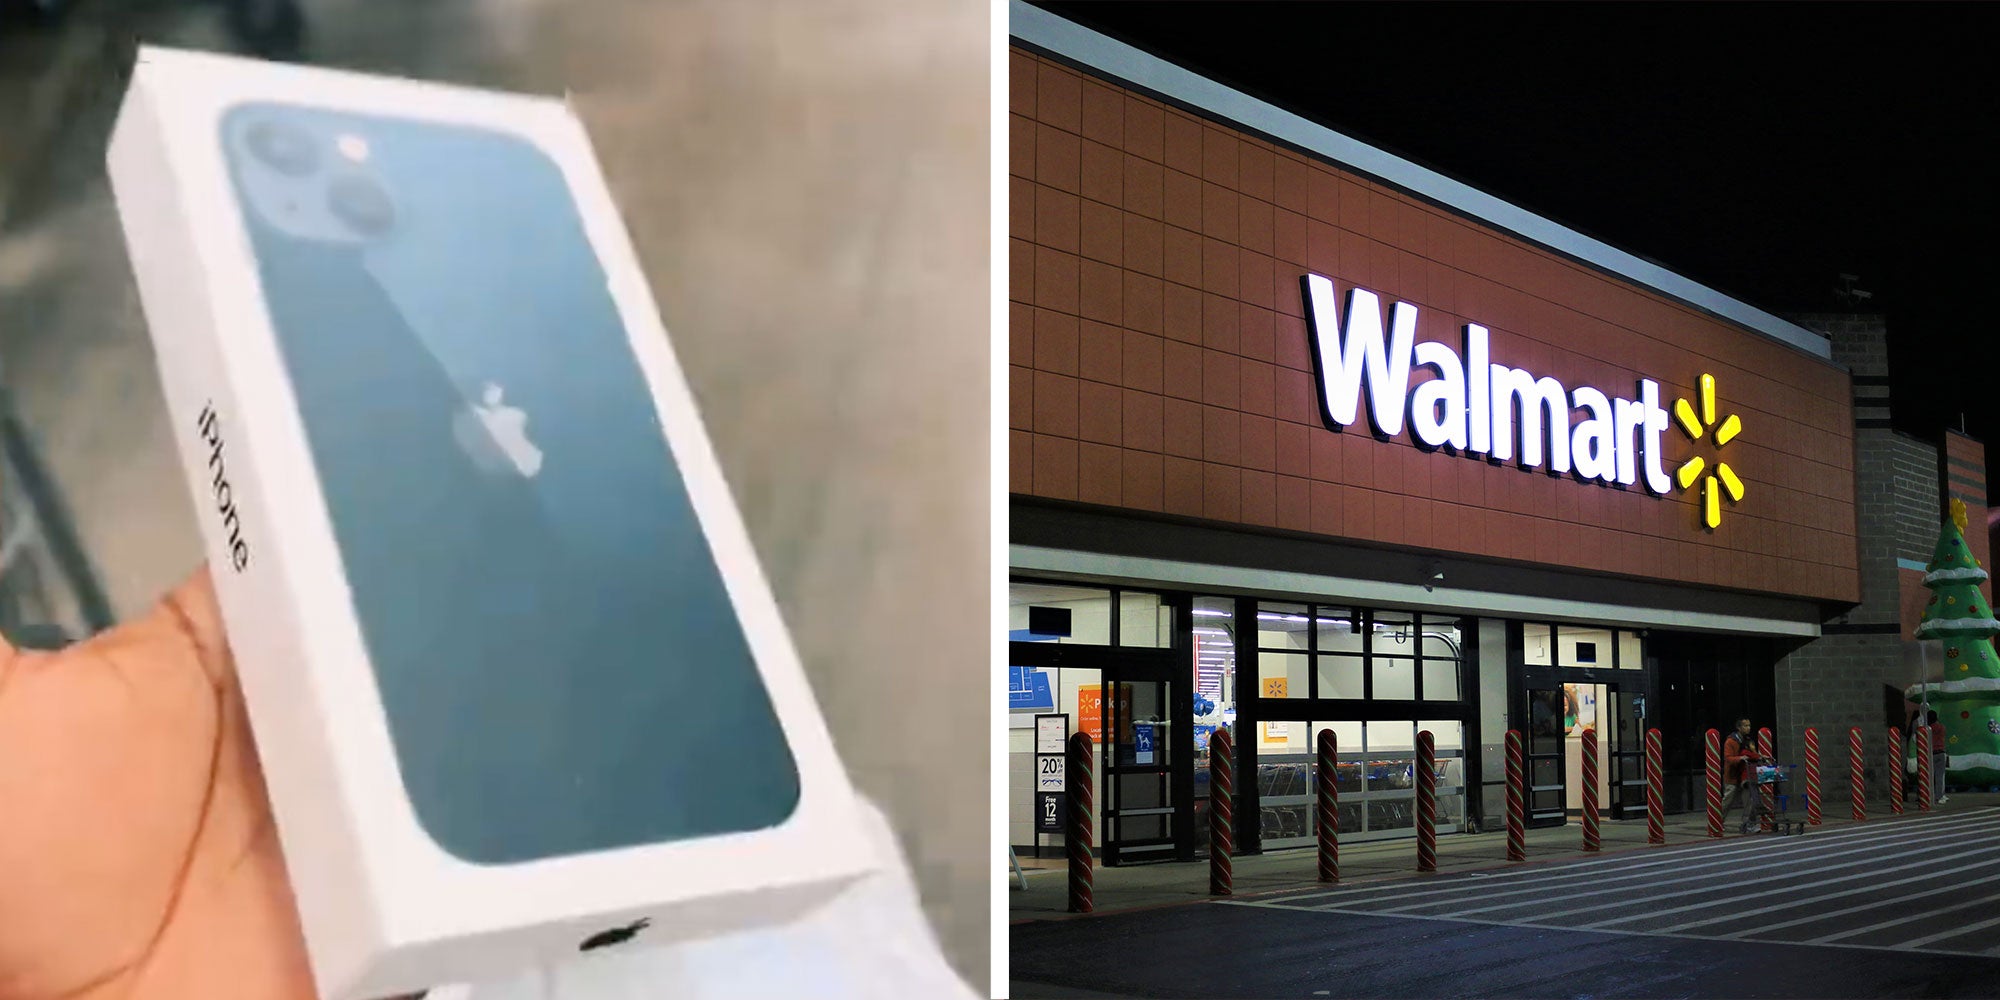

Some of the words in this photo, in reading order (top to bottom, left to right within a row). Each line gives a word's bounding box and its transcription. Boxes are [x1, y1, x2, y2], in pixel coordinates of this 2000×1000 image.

[1300, 273, 1671, 498] Walmart
[197, 398, 248, 573] iPhone
[1045, 803, 1056, 817] 12
